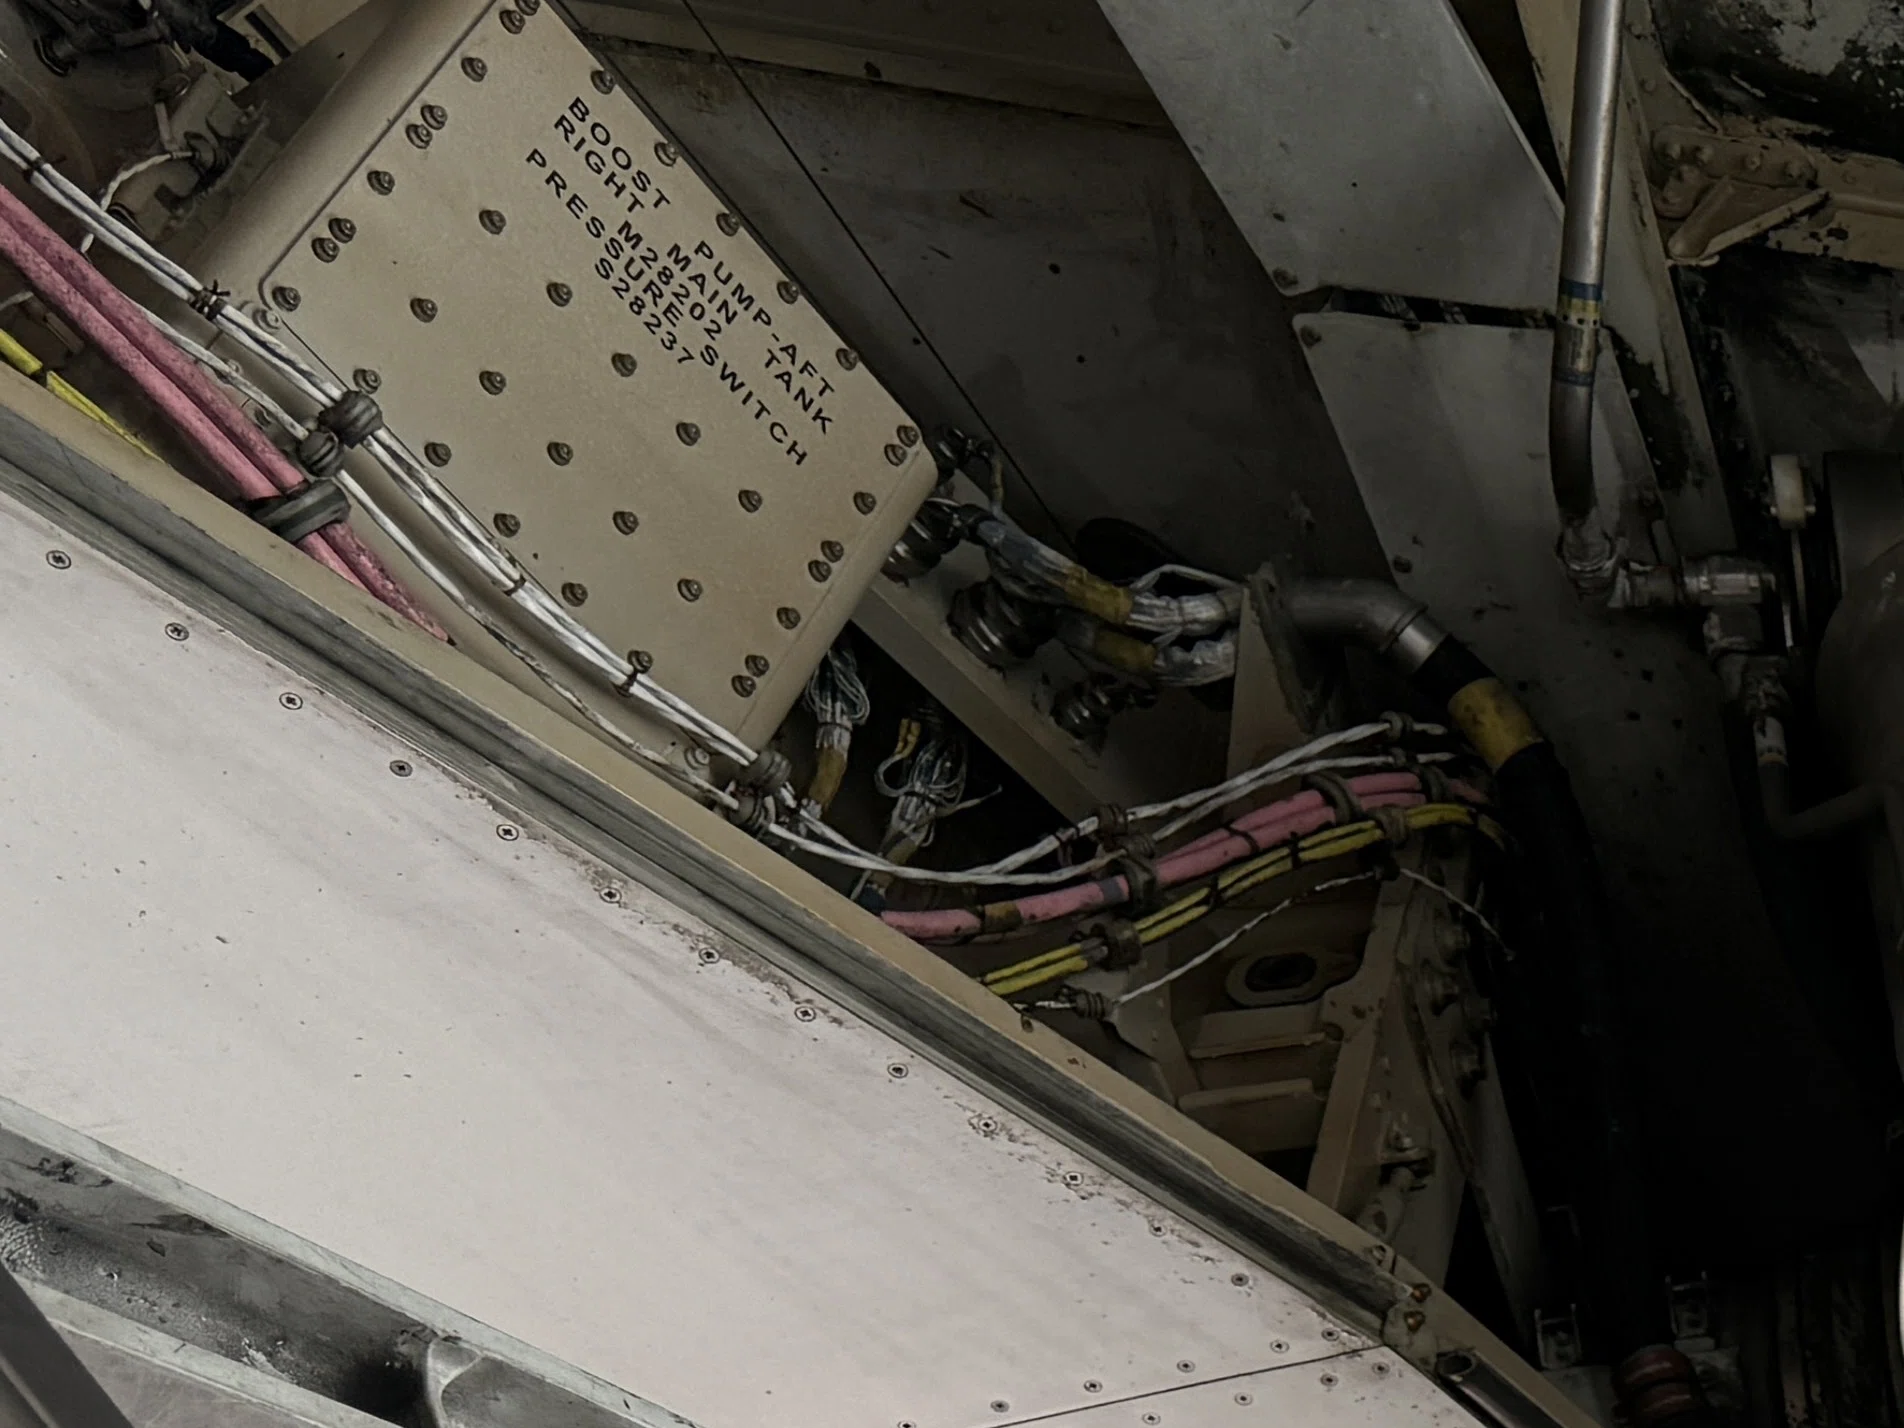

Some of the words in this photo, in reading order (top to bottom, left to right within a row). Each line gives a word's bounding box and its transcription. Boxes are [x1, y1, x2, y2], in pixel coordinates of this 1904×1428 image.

[568, 97, 671, 209] BOOST
[525, 148, 684, 328] PRESSURE
[699, 345, 809, 466] SWITCH
[553, 114, 645, 214] RIGHT
[666, 244, 739, 325] MAIN
[762, 348, 834, 435] TANK
[594, 257, 696, 365] S28237
[617, 220, 724, 340] M28202
